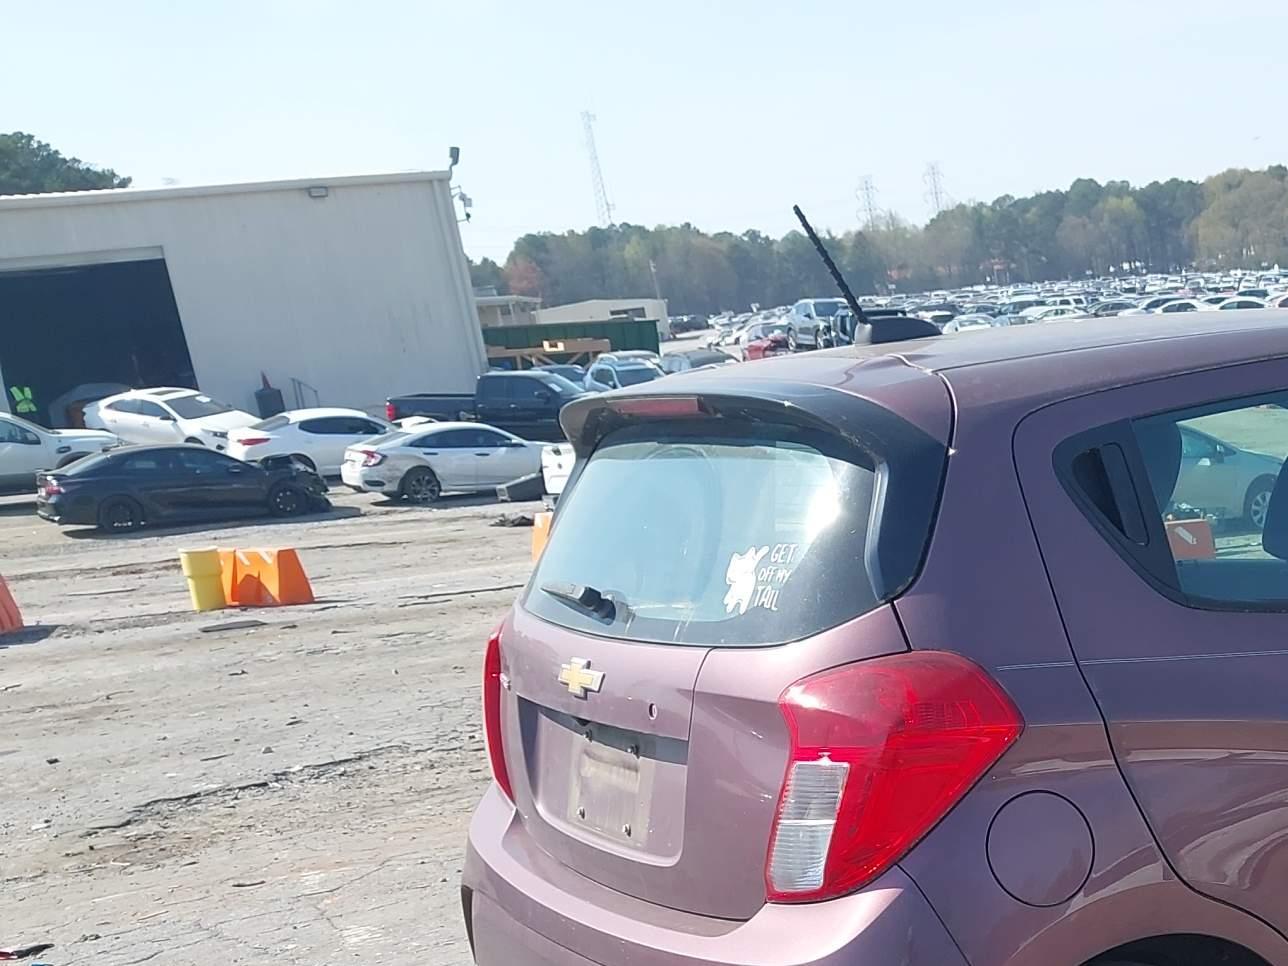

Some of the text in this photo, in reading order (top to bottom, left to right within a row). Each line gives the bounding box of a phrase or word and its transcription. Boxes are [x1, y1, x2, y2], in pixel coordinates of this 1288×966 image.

[770, 543, 798, 564] GET
[758, 565, 792, 584] OFF MY
[753, 585, 779, 611] TAIL
